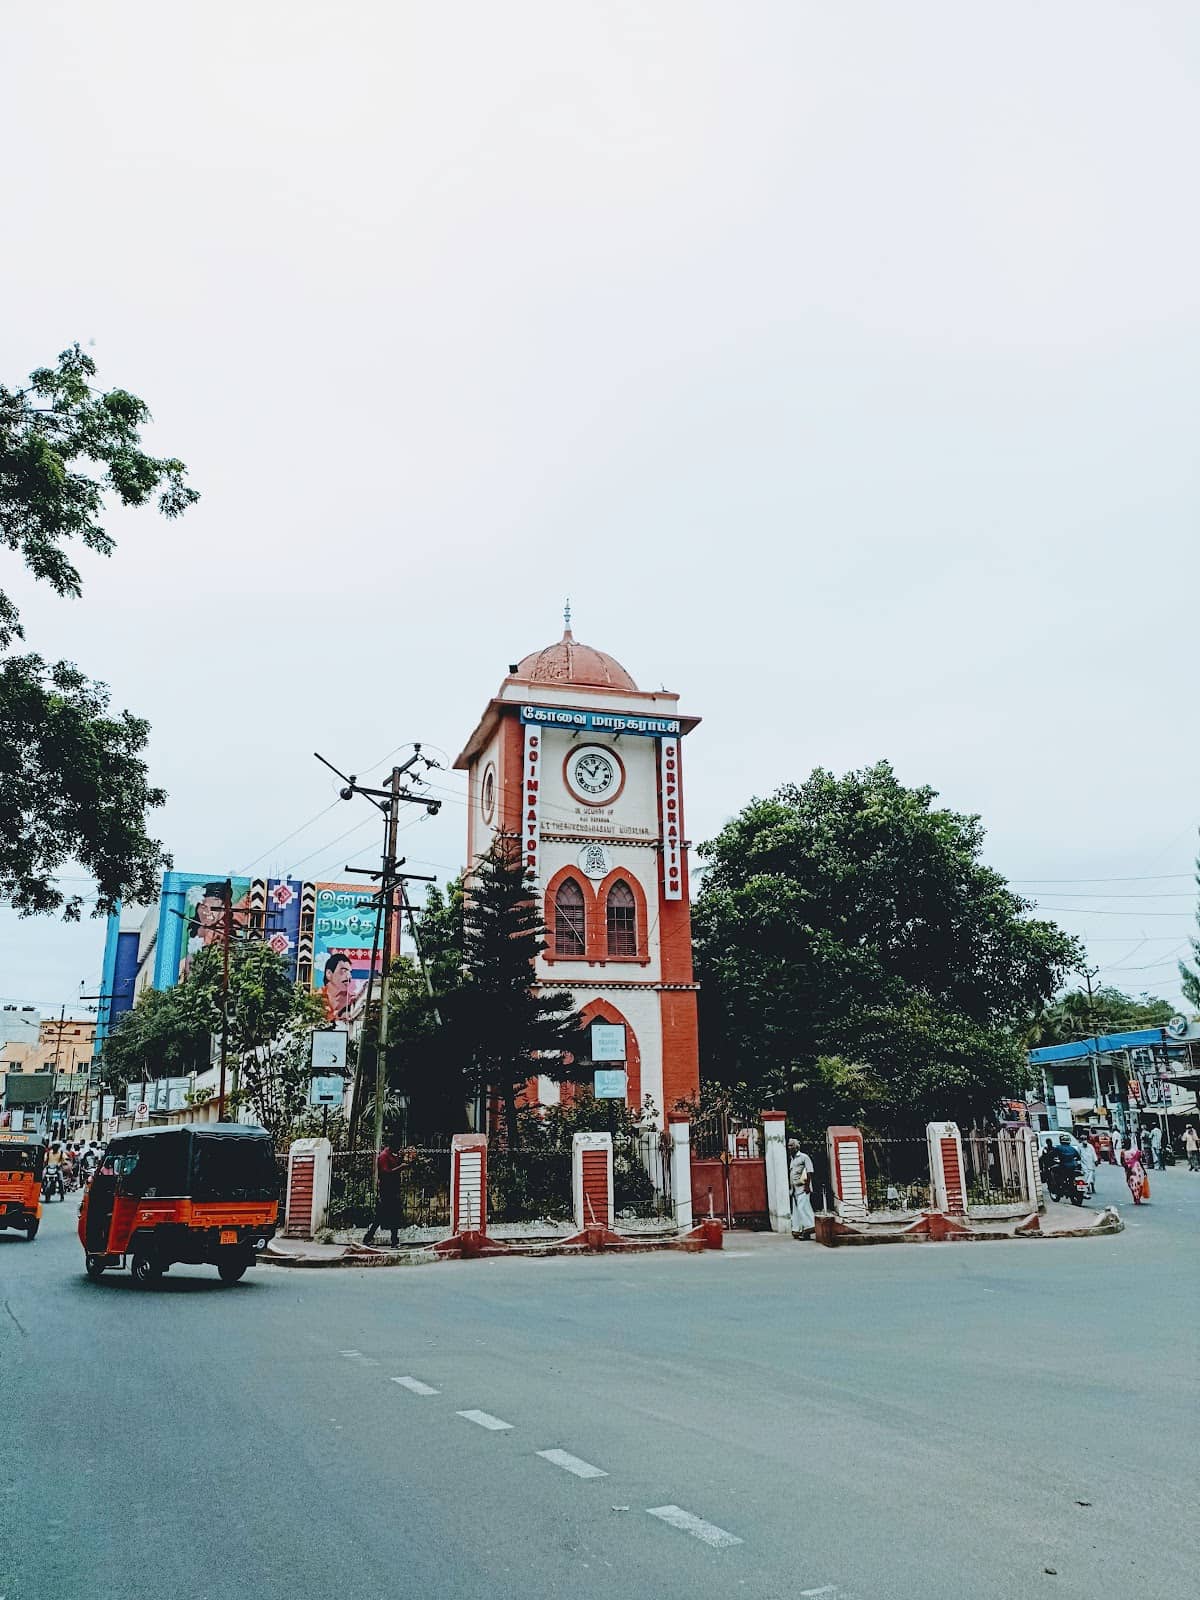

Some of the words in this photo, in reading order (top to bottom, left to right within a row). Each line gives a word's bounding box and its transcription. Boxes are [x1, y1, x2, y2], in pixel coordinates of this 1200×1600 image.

[523, 706, 587, 725] கோவை
[592, 717, 681, 733] மாநகராட்சி
[665, 746, 679, 892] CORPORATION
